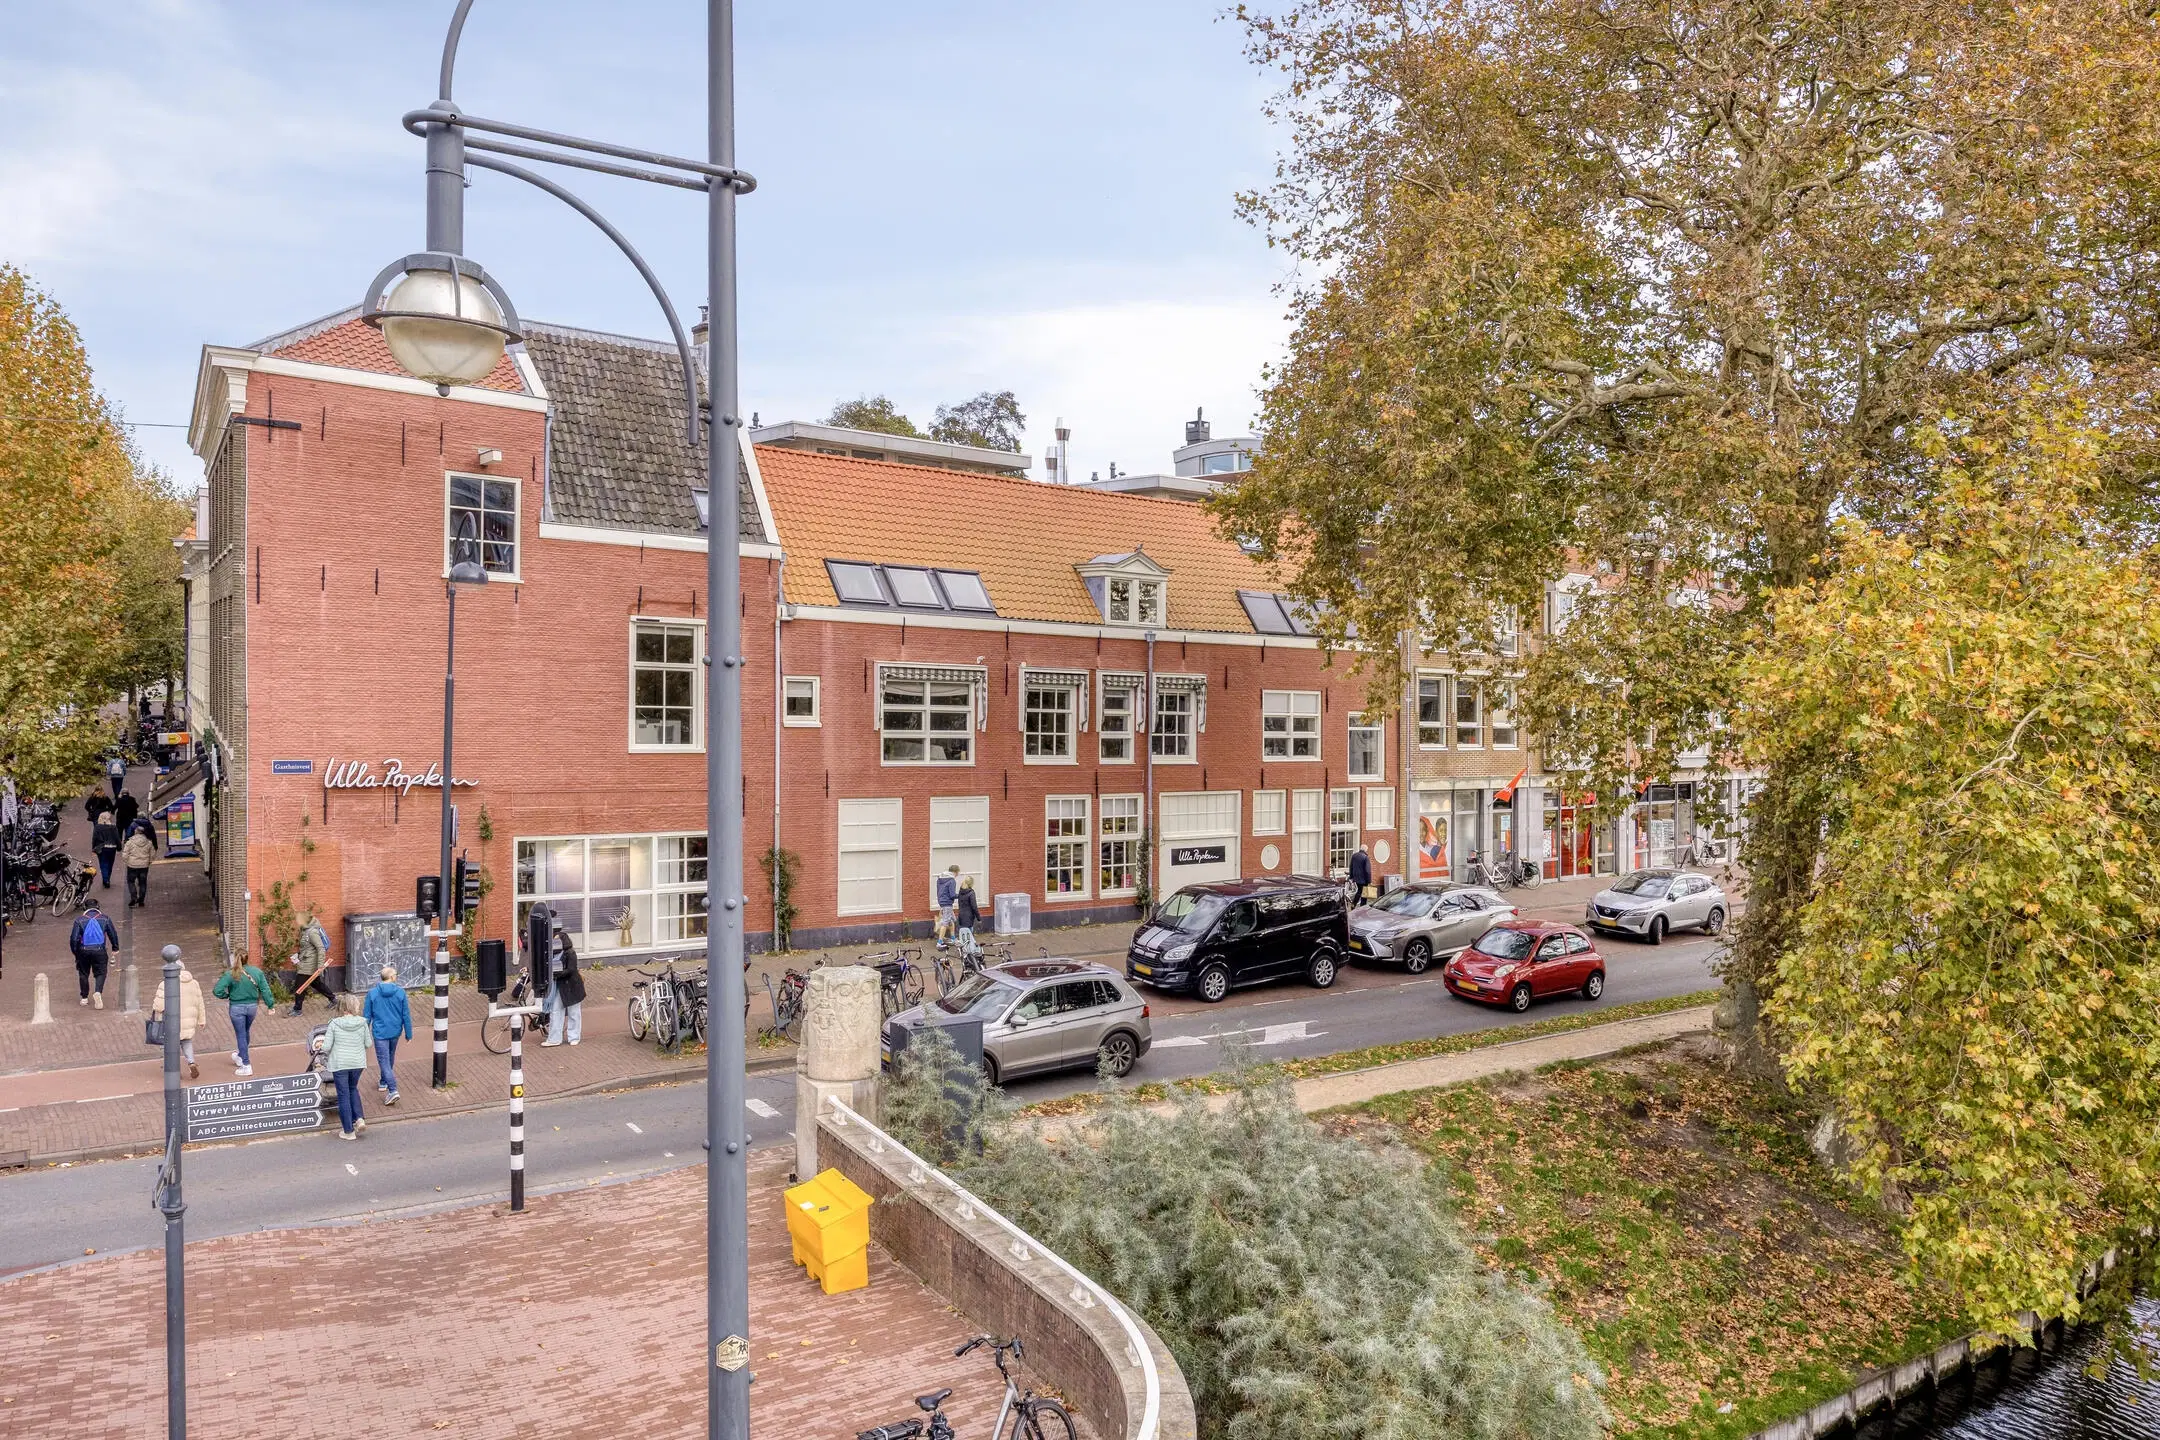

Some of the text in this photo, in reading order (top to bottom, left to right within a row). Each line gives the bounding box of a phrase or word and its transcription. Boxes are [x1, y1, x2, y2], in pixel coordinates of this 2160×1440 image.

[324, 757, 377, 788] Ulla
[1179, 849, 1219, 863] Ulla Popken
[193, 1083, 252, 1096] Frans Hals
[292, 1079, 313, 1087] HOF
[197, 1090, 242, 1102] Museum
[192, 1098, 313, 1117] Verwey Museum Haarlem
[219, 1117, 315, 1133] Architectuurcentrum
